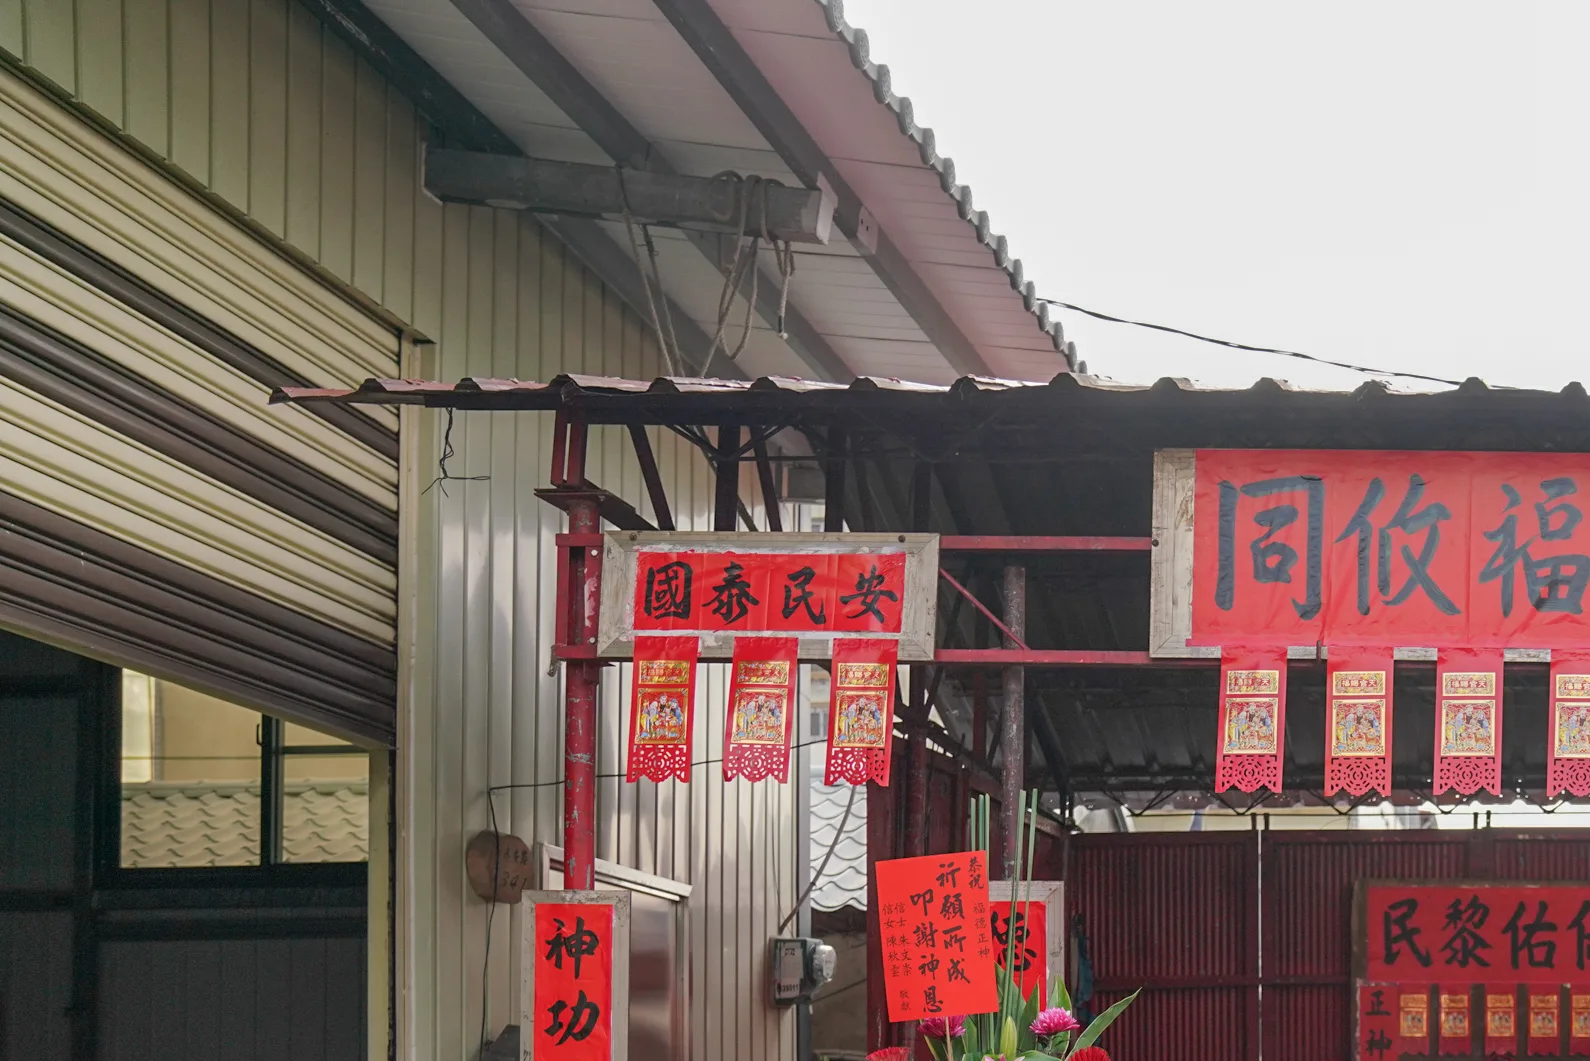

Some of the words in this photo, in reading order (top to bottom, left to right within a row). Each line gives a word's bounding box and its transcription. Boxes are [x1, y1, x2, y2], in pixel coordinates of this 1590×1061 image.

[643, 560, 898, 625] 國泰民安
[910, 889, 944, 1013] 叩謝神恩
[973, 901, 990, 959] 福德正神
